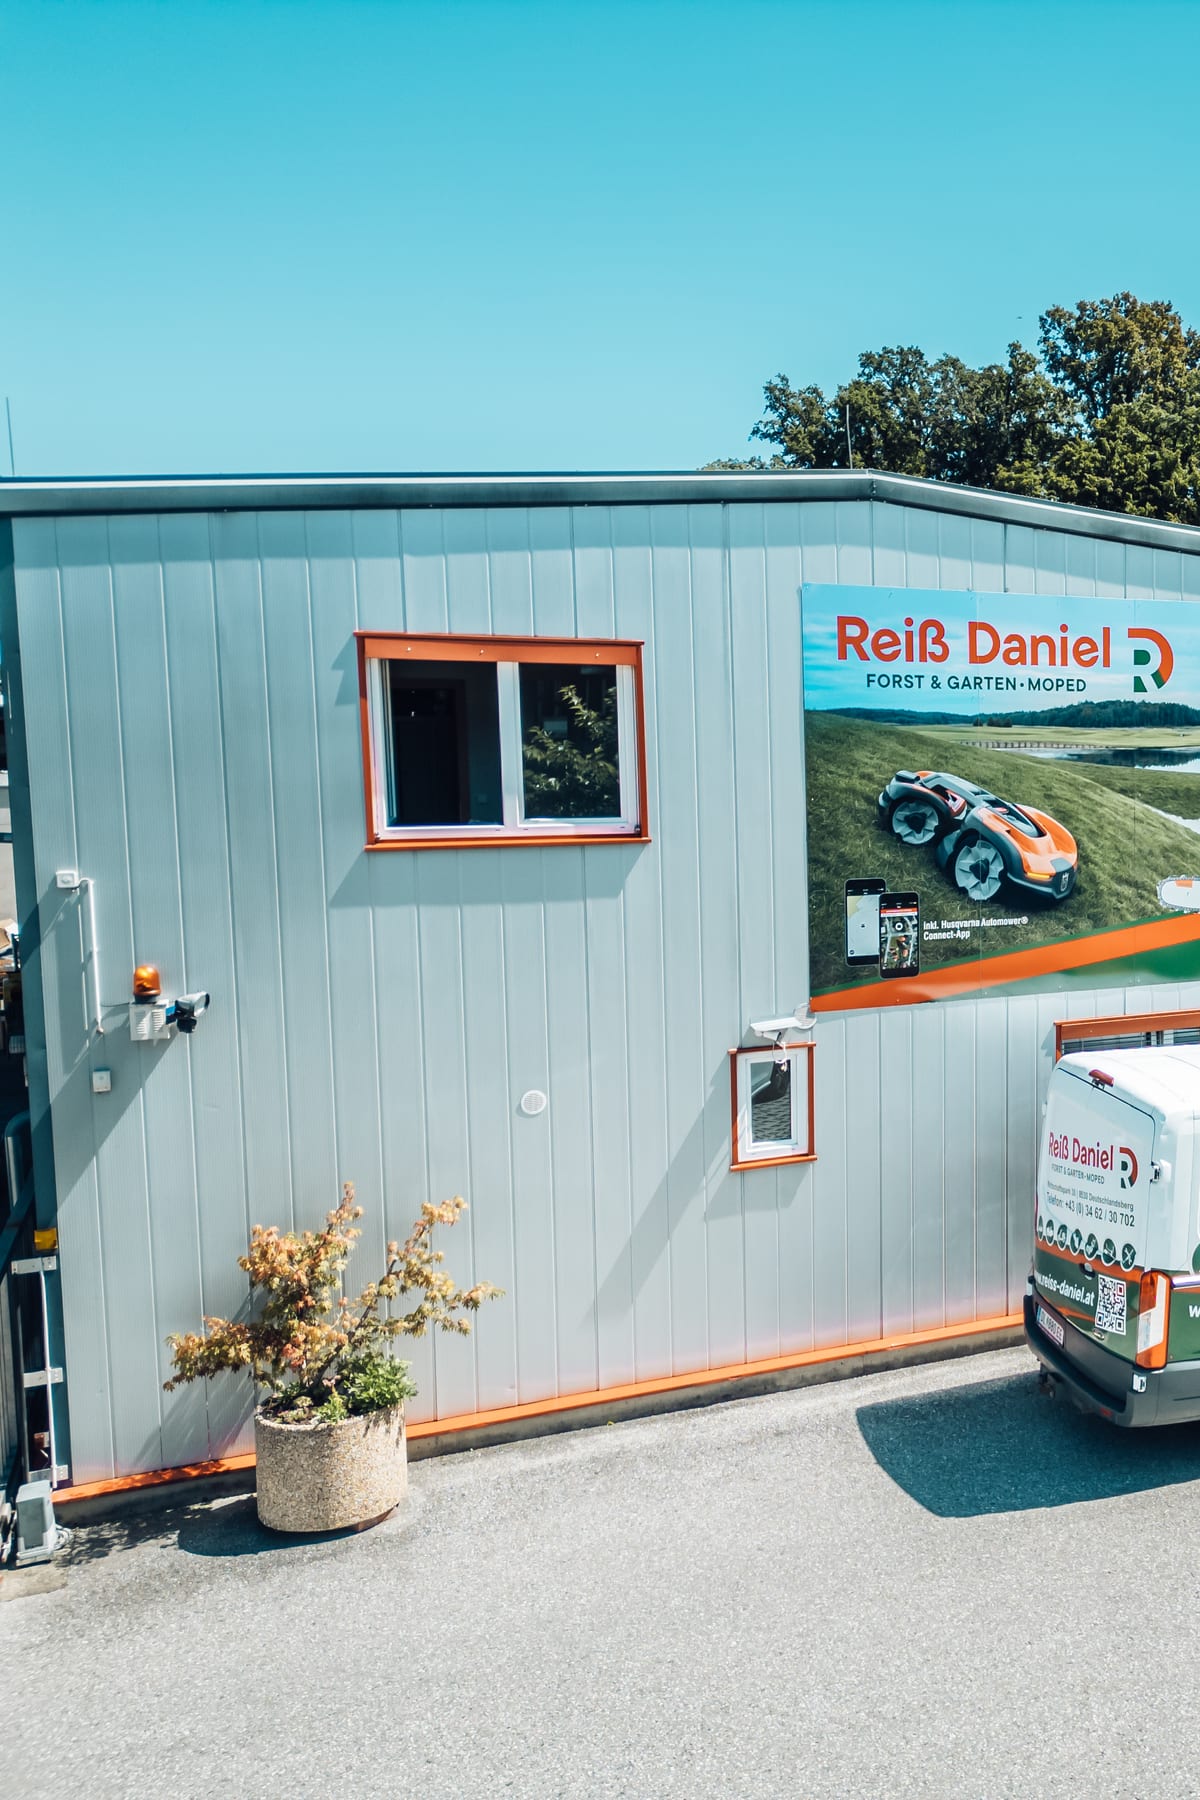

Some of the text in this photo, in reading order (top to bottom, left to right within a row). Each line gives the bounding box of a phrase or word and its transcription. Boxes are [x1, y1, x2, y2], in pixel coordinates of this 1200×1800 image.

[836, 615, 950, 663] Reiß
[967, 621, 1111, 668] Daniel
[866, 673, 924, 689] FORST
[930, 674, 942, 690] &
[941, 919, 980, 930] Husqvarna
[923, 930, 971, 941] Connect-App
[1048, 1131, 1069, 1161] Reiß
[1072, 1136, 1114, 1171] Daniel
[1085, 1204, 1093, 1217] 34
[1094, 1207, 1103, 1220] 62
[1109, 1210, 1118, 1224] 30
[1119, 1213, 1135, 1228] 702
